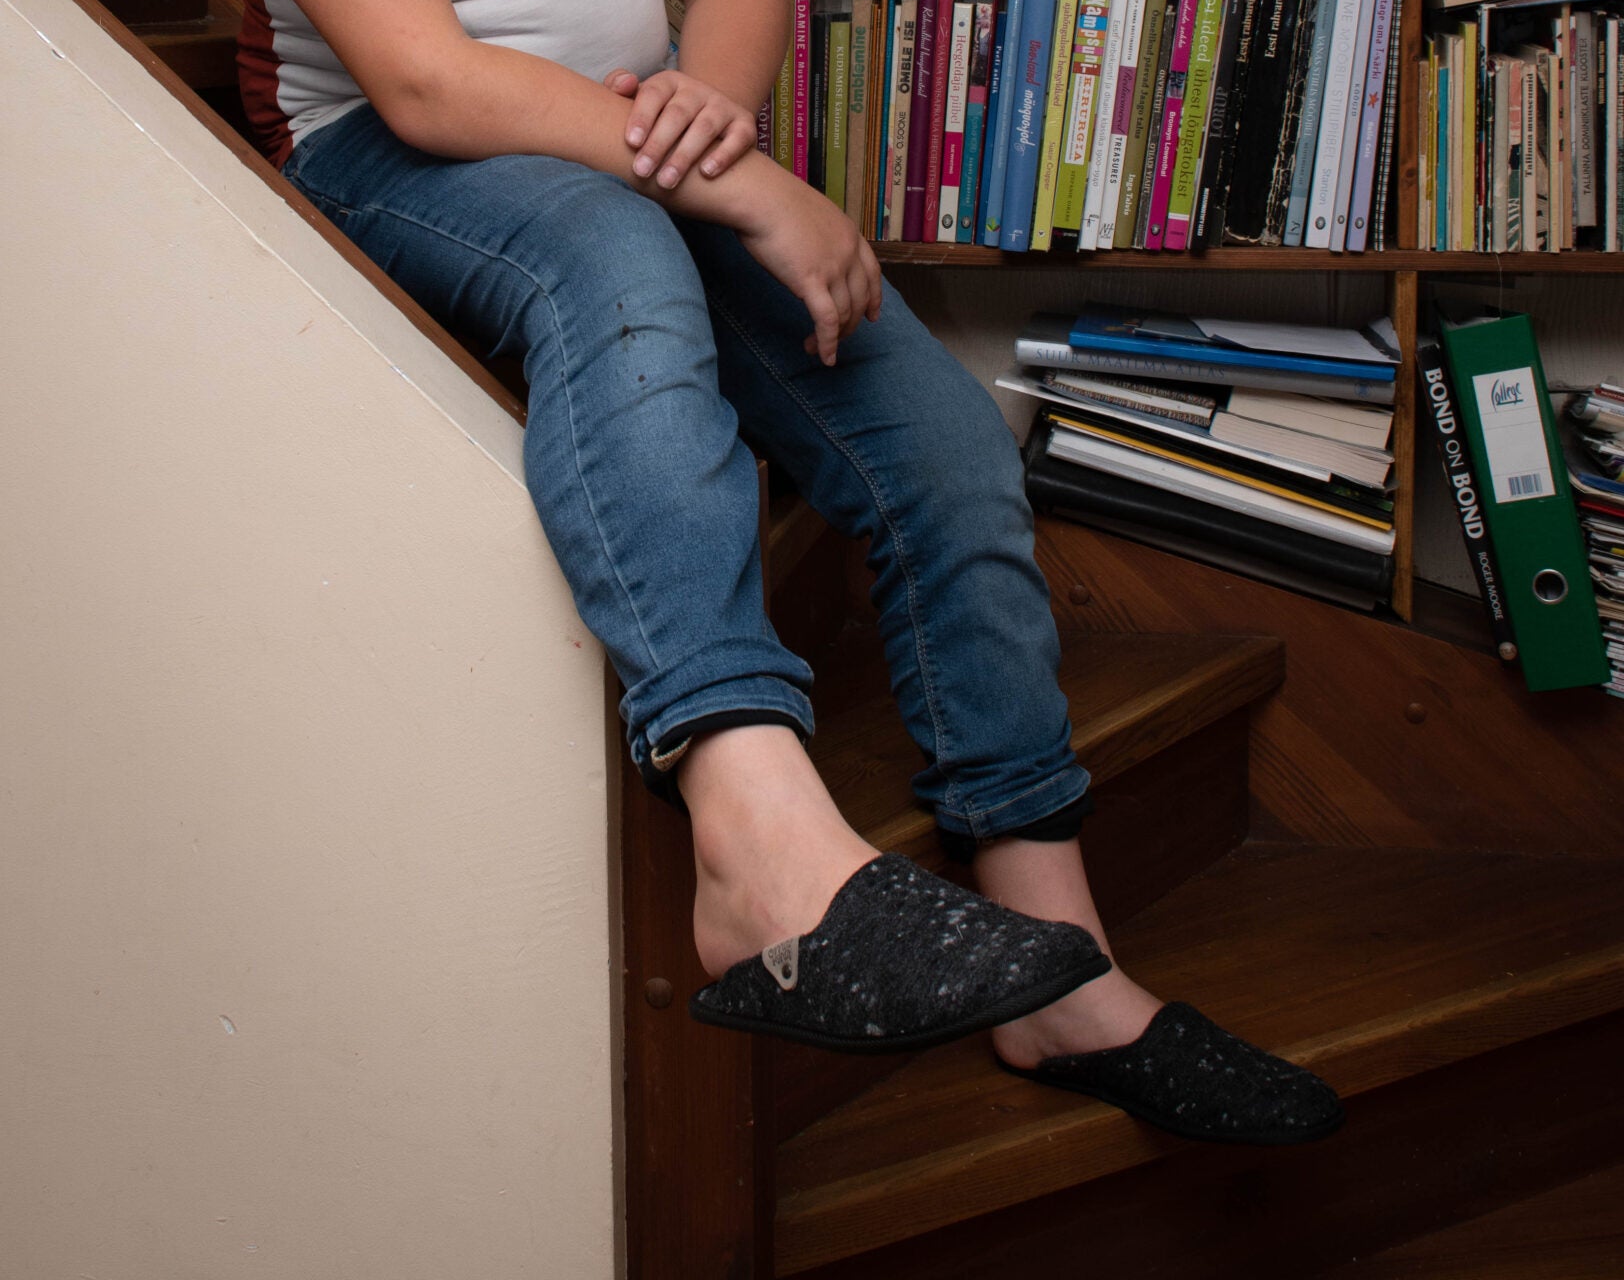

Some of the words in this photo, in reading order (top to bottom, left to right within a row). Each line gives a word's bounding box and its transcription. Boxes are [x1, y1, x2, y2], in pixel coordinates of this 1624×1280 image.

[834, 46, 845, 98] KUDUMISE
[952, 34, 966, 92] Heegeldaja
[1580, 38, 1588, 83] KLOOSTER
[797, 62, 806, 97] Mustrid
[797, 112, 806, 138] ideed
[833, 101, 843, 149] käsiraamat
[949, 95, 962, 124] piibel
[1162, 111, 1176, 140] Bronwyn
[1160, 142, 1174, 177] Lowenthal
[1525, 137, 1534, 176] Tallinna
[1124, 173, 1136, 192] Inga
[1583, 157, 1592, 196] TALLINNA
[1035, 347, 1082, 365] SUUR
[1087, 354, 1170, 374] MAAILMA
[1175, 361, 1227, 379] ATLAS
[1425, 366, 1457, 436] BOND
[1445, 438, 1464, 468] ON
[1451, 473, 1485, 540] BOND
[1477, 550, 1493, 586] ROGER
